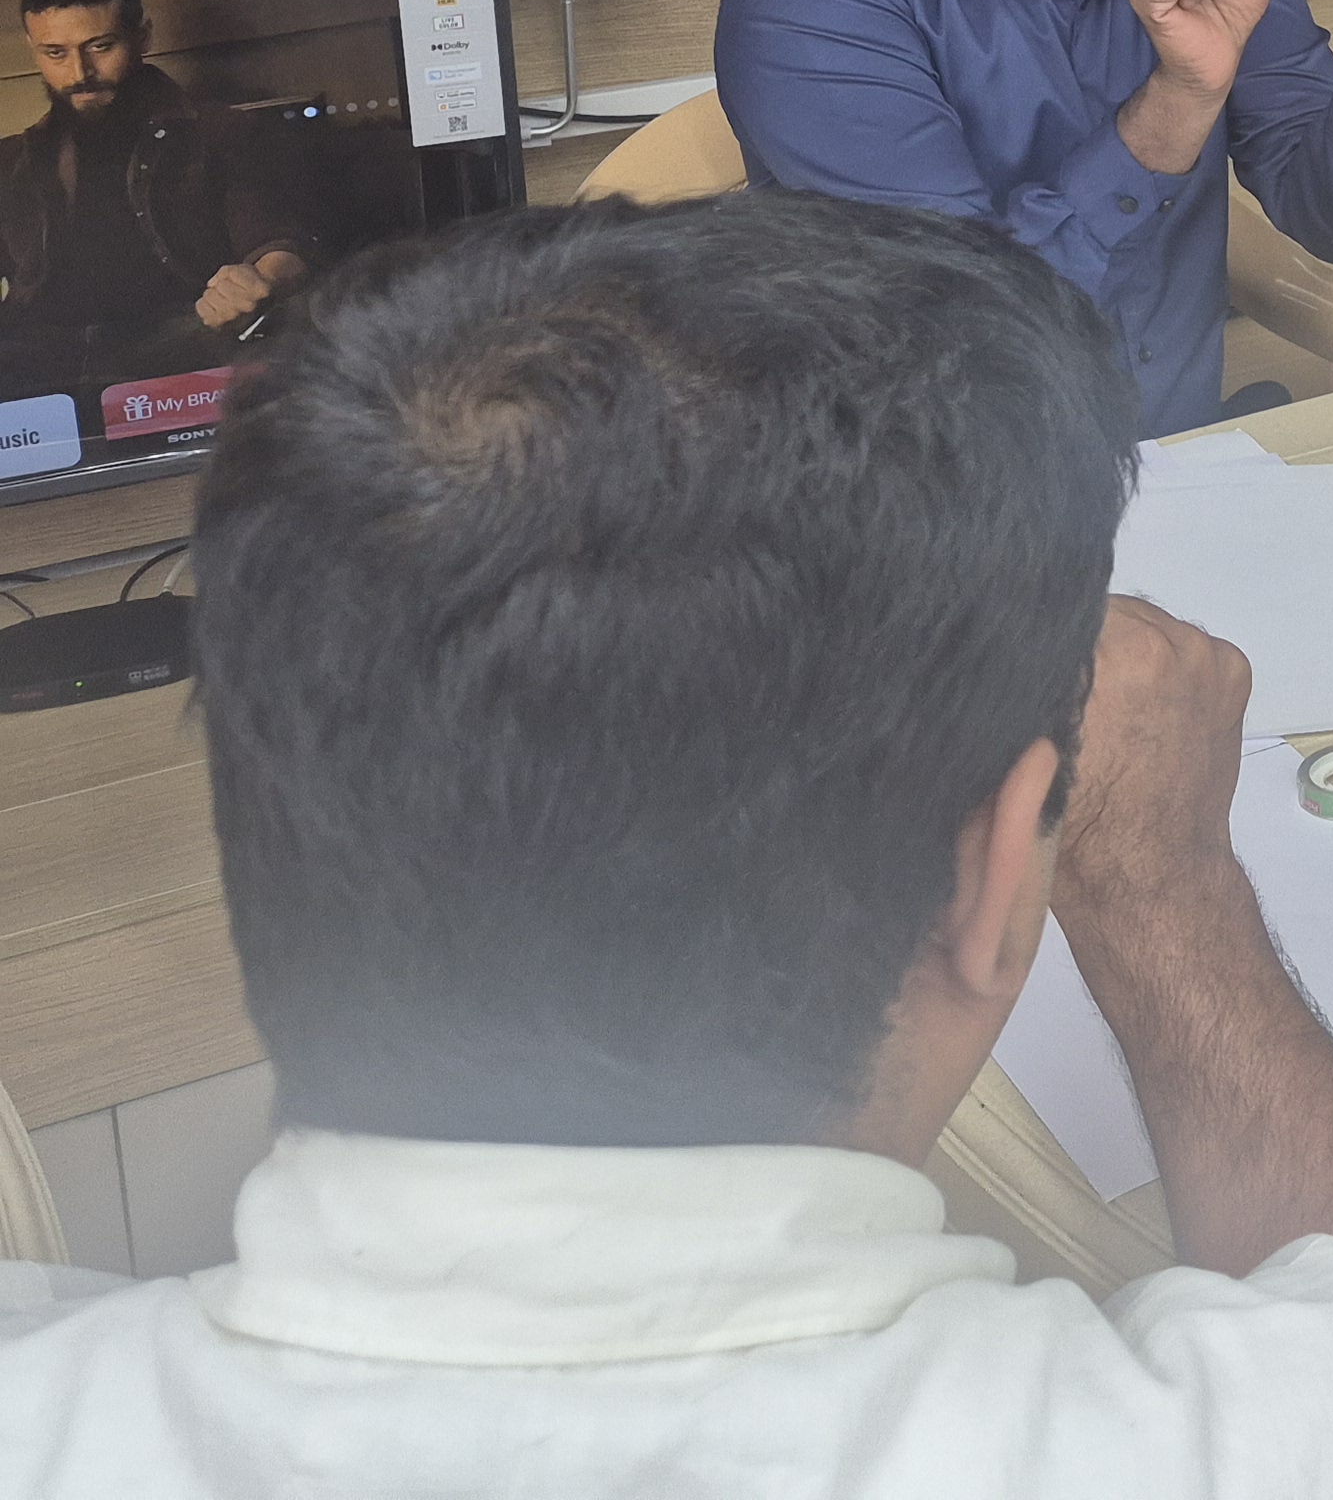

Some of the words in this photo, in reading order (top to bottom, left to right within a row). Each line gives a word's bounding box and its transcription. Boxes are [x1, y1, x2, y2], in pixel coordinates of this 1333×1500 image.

[443, 41, 470, 51] Dolby
[157, 398, 184, 412] My
[168, 428, 216, 443] SONY
